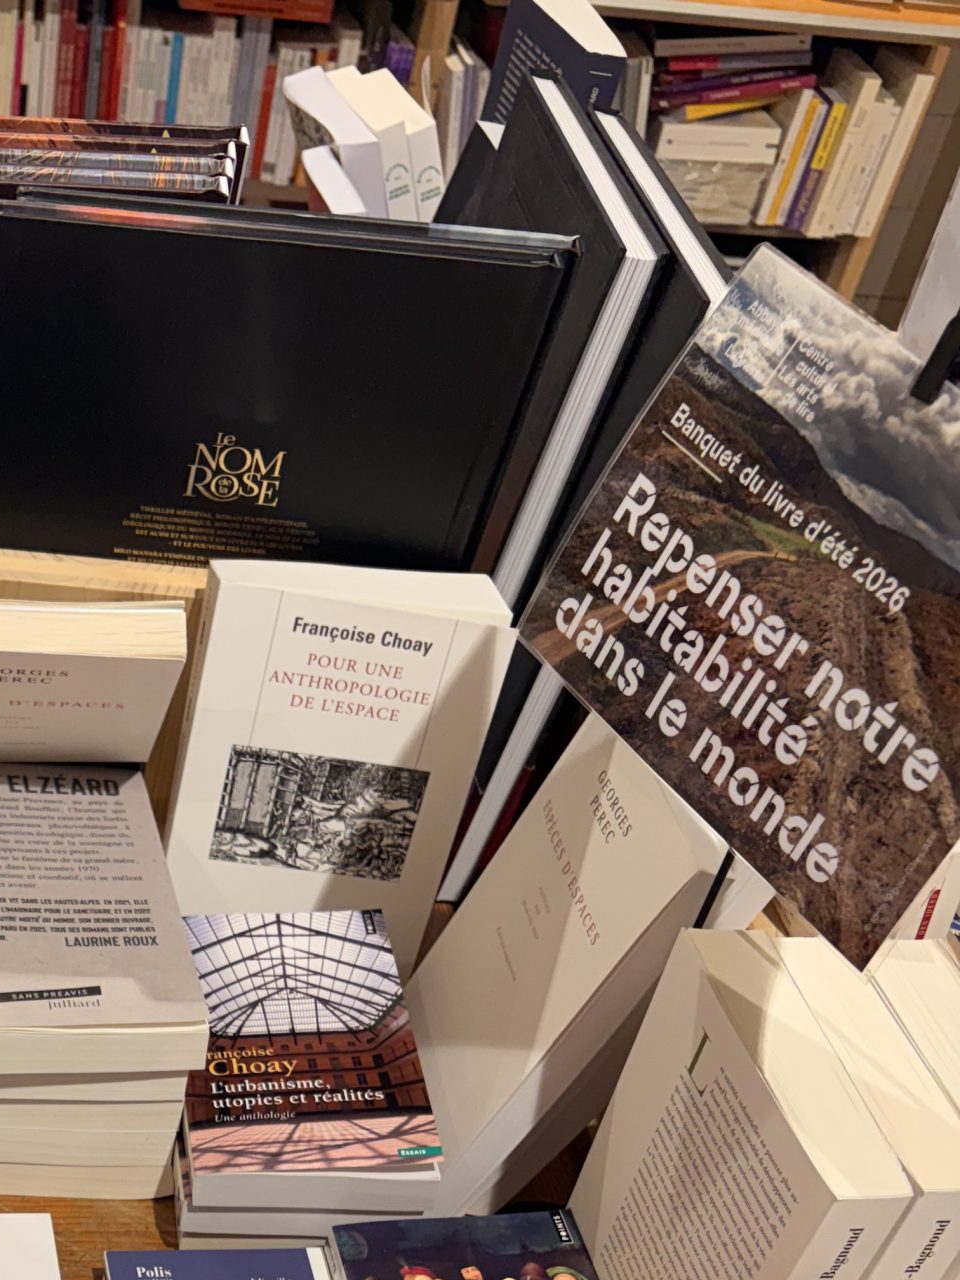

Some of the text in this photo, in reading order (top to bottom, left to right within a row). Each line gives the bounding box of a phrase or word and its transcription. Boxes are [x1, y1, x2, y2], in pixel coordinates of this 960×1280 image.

[193, 442, 287, 478] NOM
[182, 464, 280, 507] ROSE
[670, 403, 912, 613] Banquet livre d'été 2026
[292, 616, 434, 657] Françoise Choay
[581, 528, 820, 766] habitabilité
[612, 472, 940, 792] Repenser notre
[306, 653, 404, 680] POUR UNE
[269, 670, 431, 706] ANTHROPOLOGIE
[321, 699, 400, 722] L'ESPACE
[555, 593, 841, 884] dans monde
[8, 774, 120, 797] ELZÉARD
[598, 769, 633, 838] GEORGES
[590, 794, 616, 844] PEREC
[65, 935, 159, 948] LAURINE ROUX
[208, 1058, 298, 1077] Choay
[211, 1078, 331, 1095] L'urbanisme,
[212, 1089, 385, 1110] utopies réalités
